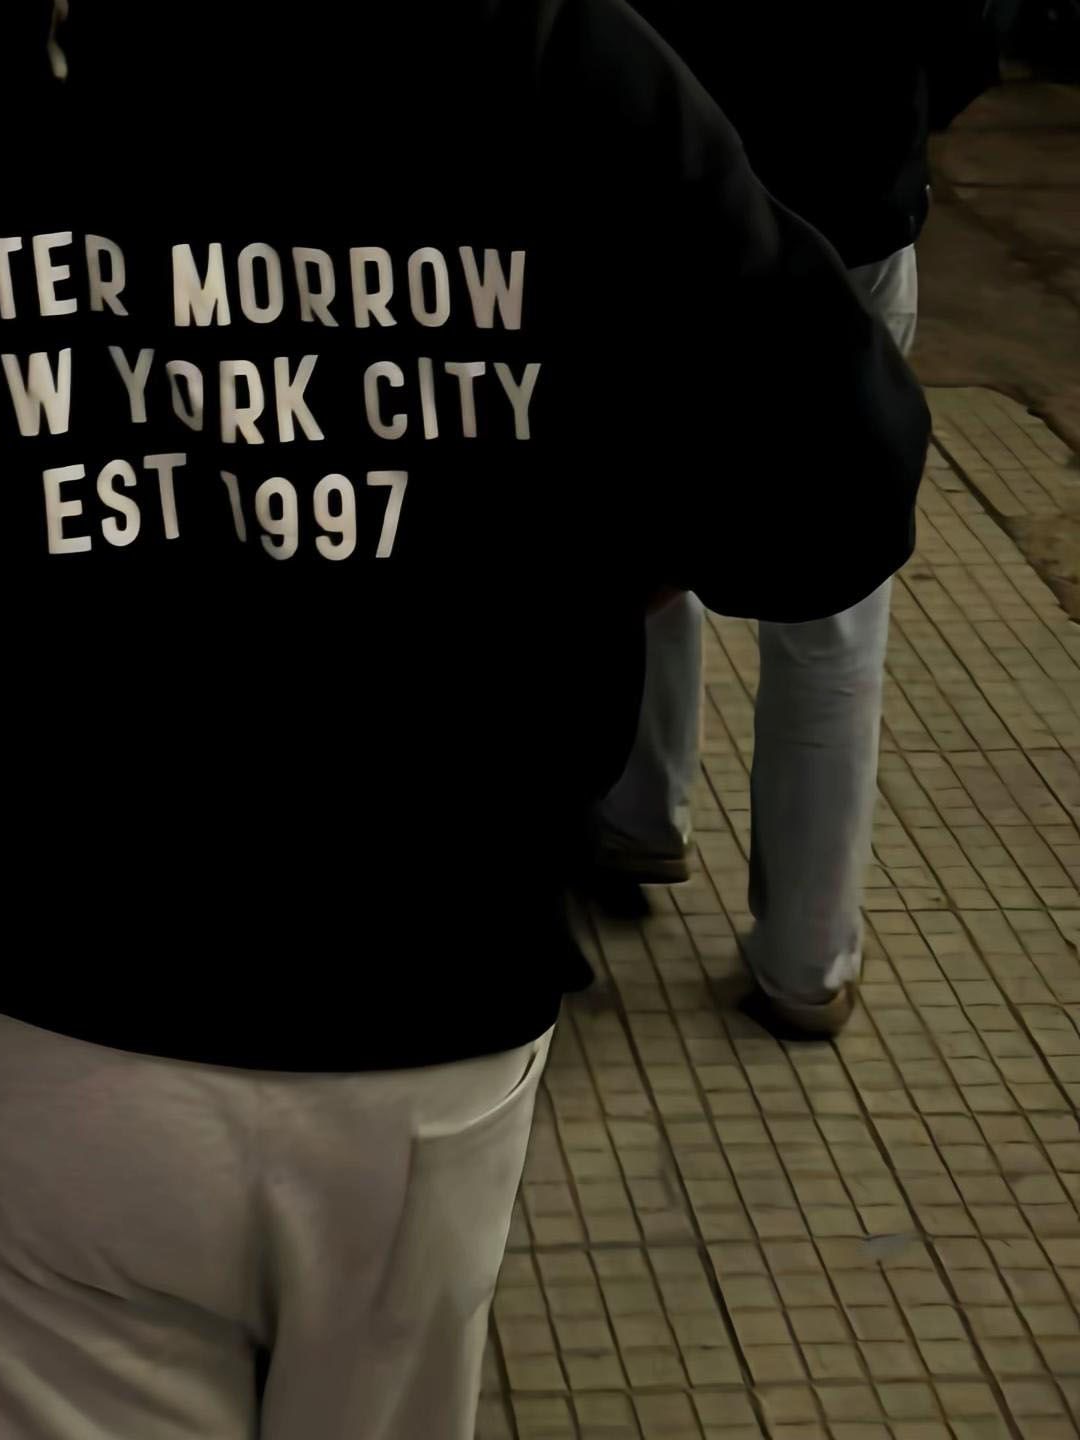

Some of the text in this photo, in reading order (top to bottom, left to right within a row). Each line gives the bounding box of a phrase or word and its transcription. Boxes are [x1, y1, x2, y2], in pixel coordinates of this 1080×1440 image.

[172, 242, 527, 331] MORROW
[108, 346, 326, 445] YORK
[364, 357, 542, 441] CITY
[43, 453, 409, 562] EST 1997
